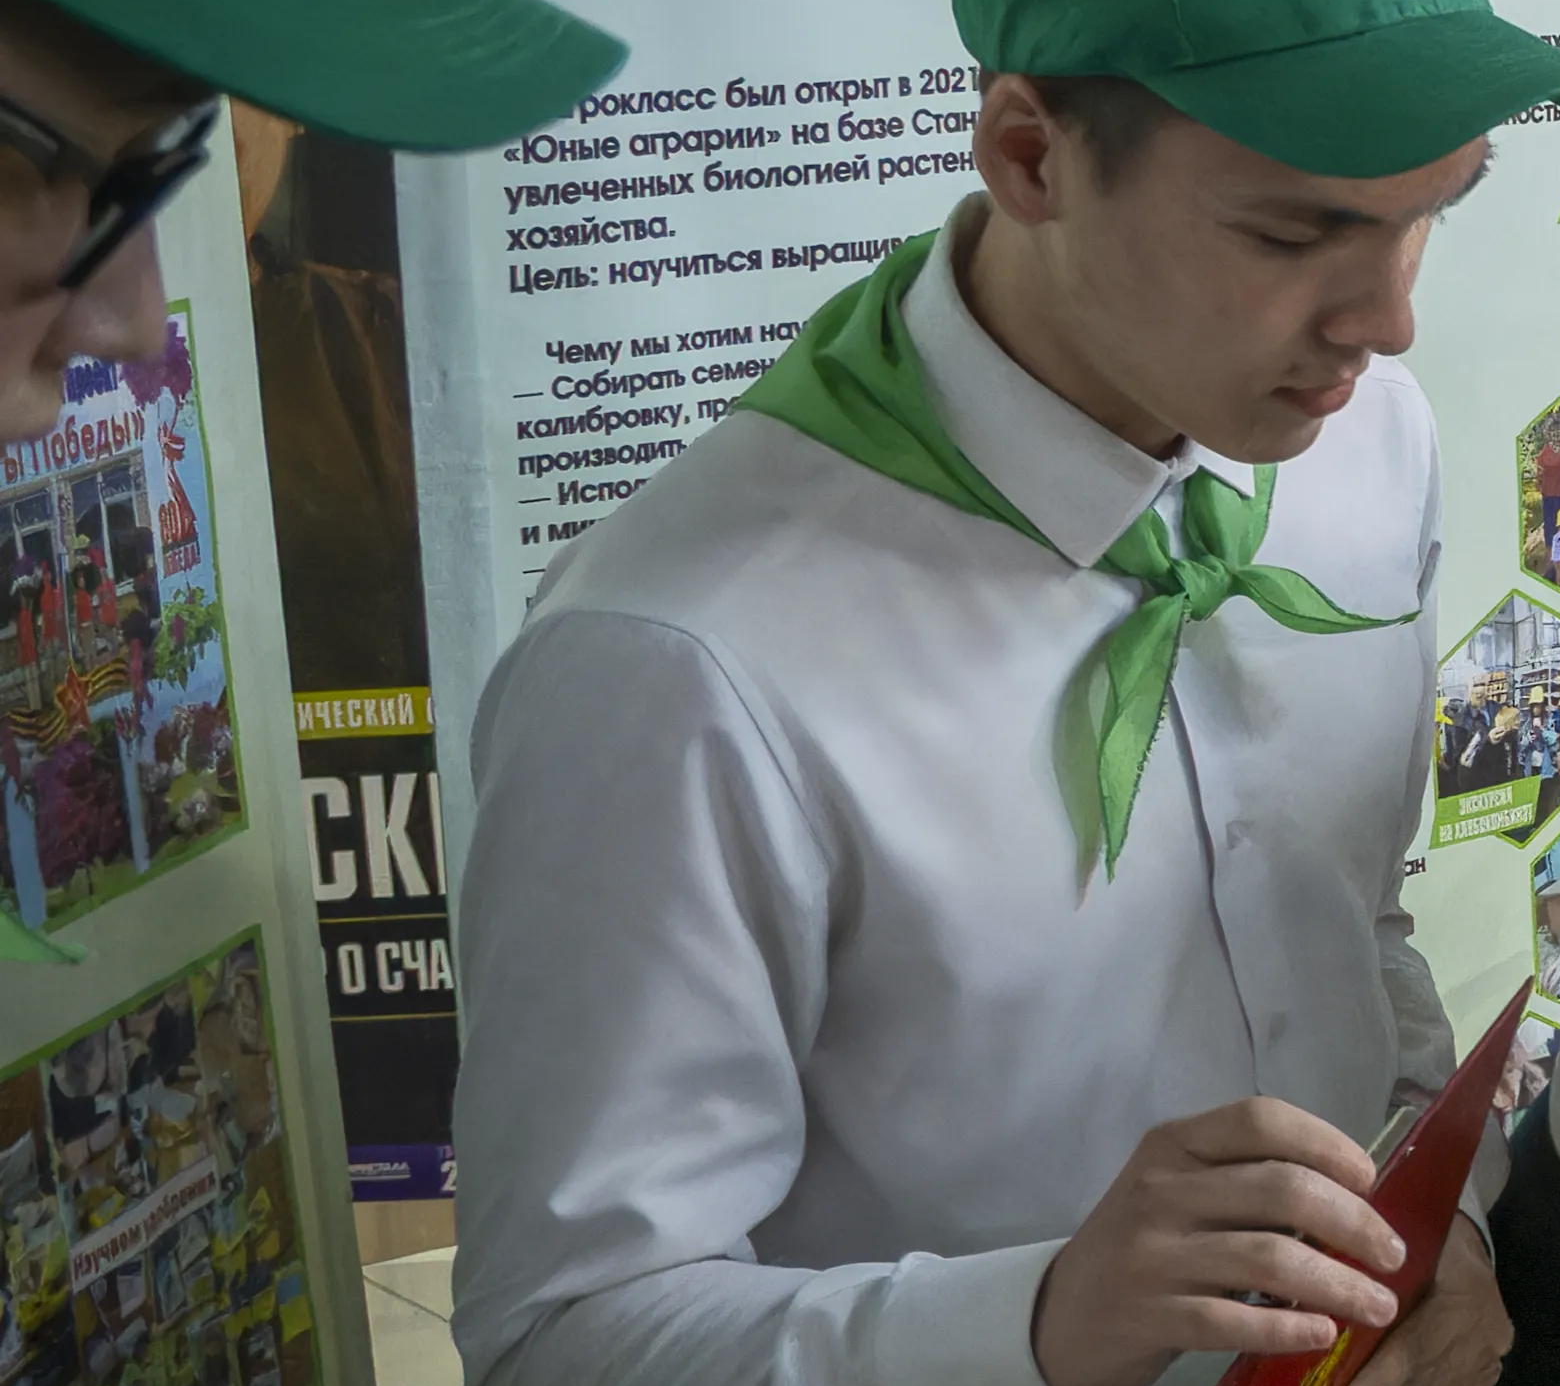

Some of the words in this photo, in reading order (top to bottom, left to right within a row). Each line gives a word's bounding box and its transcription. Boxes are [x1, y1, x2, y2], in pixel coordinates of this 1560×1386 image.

[726, 78, 786, 108] был
[795, 77, 891, 110] открыт
[919, 67, 981, 95] 2021
[504, 133, 620, 164] «Юные
[630, 127, 781, 160] аграрии»
[792, 123, 830, 146] на
[838, 112, 905, 142] базе
[504, 172, 694, 214] увлеченных
[703, 155, 870, 192] биологией
[506, 216, 676, 251] хозяйства.
[509, 261, 598, 295] Цель:
[609, 251, 762, 285] научиться
[546, 339, 622, 366] Чему
[677, 327, 752, 352] хотим
[551, 368, 686, 400] Собирать
[517, 400, 691, 440] калибровку,
[517, 438, 687, 478] производить
[298, 692, 415, 733] ИЧЕСКИЙ
[339, 944, 364, 995] О
[378, 940, 453, 994] СЧА
